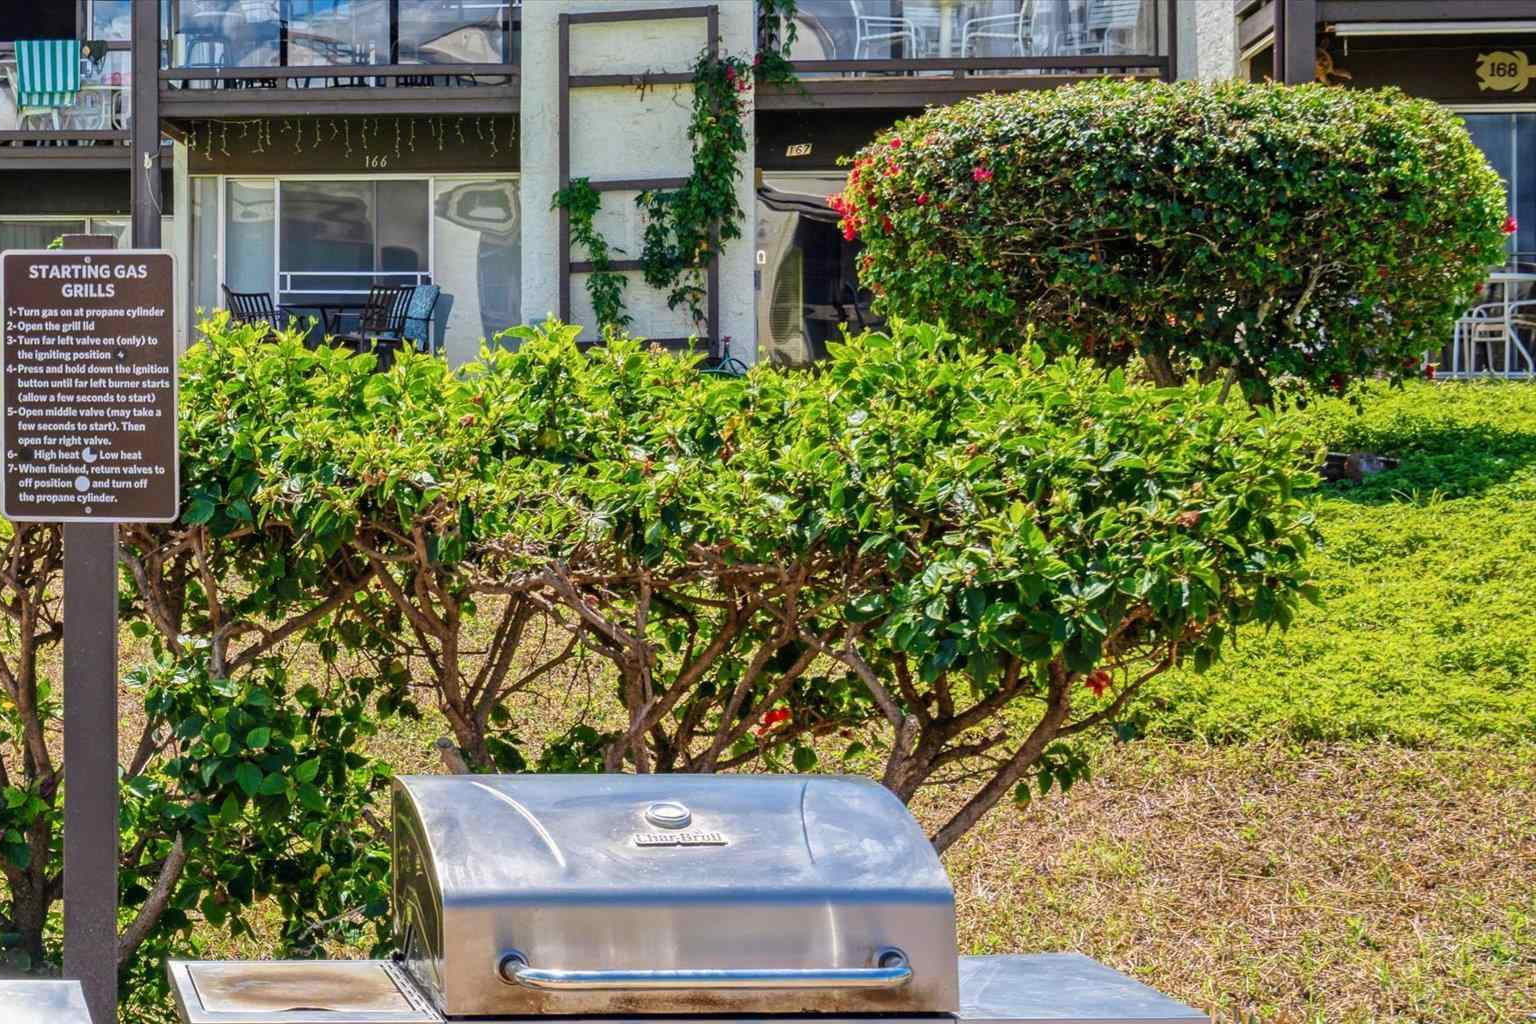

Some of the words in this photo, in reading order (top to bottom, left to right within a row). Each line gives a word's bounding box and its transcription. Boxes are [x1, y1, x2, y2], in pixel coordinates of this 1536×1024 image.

[1488, 62, 1518, 77] 168
[366, 155, 388, 168] 166
[29, 264, 111, 279] STARTING
[114, 264, 148, 279] GAS
[61, 283, 115, 298] GRILLS
[41, 309, 58, 318] gas
[60, 309, 72, 317] on
[74, 307, 84, 317] at
[85, 309, 125, 318] propane
[126, 307, 165, 318] cylinder
[44, 321, 60, 331] the
[62, 321, 81, 332] grill
[83, 321, 95, 331] lid
[42, 335, 56, 345] far
[57, 335, 74, 345] left
[75, 335, 101, 345] valve
[102, 337, 115, 345] on
[116, 335, 146, 346] (only)
[147, 336, 158, 345] to
[17, 350, 33, 359] the
[35, 350, 71, 361] igniting
[73, 350, 111, 361] position
[45, 364, 63, 374] and
[65, 364, 86, 374] hold
[87, 364, 113, 374] down
[115, 364, 131, 374] the
[132, 364, 169, 376] ignition
[18, 378, 49, 388] button
[51, 378, 73, 388] until
[74, 378, 88, 388] far
[90, 378, 107, 388] left
[108, 378, 140, 388] burner
[142, 379, 170, 388] starts
[18, 393, 48, 403] (allow
[57, 393, 74, 402] few
[76, 393, 115, 402] seconds
[116, 393, 127, 402] to
[128, 393, 156, 403] start)
[45, 407, 78, 417] middle
[79, 407, 105, 417] valve
[106, 407, 131, 418] (may
[133, 407, 154, 417] take
[155, 409, 162, 417] a
[18, 421, 36, 431] few
[37, 421, 76, 431] seconds
[77, 422, 88, 431] to
[89, 421, 120, 432] start).
[121, 421, 146, 431] Then
[18, 437, 42, 446] open
[43, 436, 57, 445] far
[59, 436, 82, 446] right
[83, 436, 112, 445] valve.
[7, 451, 18, 459] 6-
[34, 451, 57, 460] High
[58, 451, 80, 459] heat
[99, 451, 119, 460] Low
[120, 451, 142, 460] heat
[48, 465, 89, 475] finished,
[91, 465, 121, 474] return
[122, 465, 153, 474] valves
[154, 465, 165, 474] to
[18, 478, 33, 488] off
[34, 478, 73, 489] position
[92, 478, 110, 488] and
[111, 479, 132, 488] turn
[133, 478, 148, 489] off
[19, 493, 35, 502] the
[36, 494, 75, 503] propane
[77, 493, 118, 503] cylinder.
